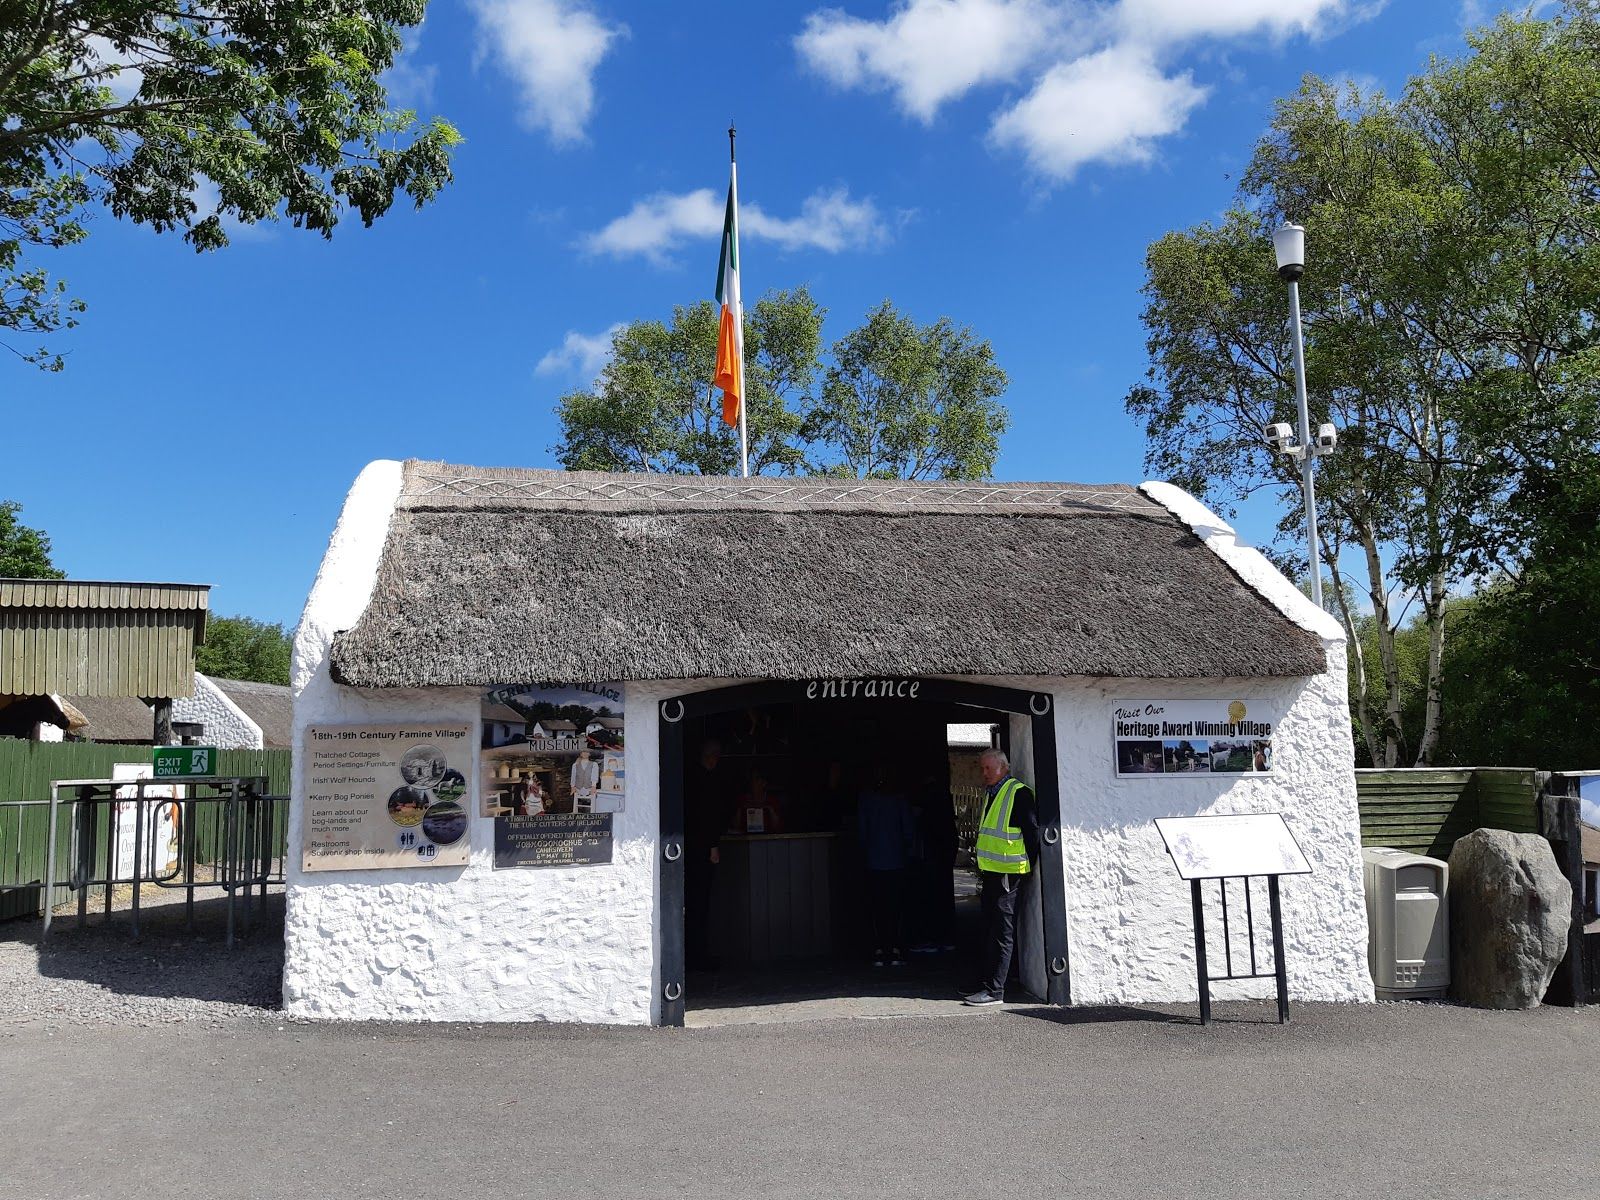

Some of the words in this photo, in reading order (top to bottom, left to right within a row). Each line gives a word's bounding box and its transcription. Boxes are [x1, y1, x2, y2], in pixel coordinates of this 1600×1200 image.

[806, 679, 920, 699] entrance
[1115, 707, 1141, 720] Visit
[1144, 704, 1165, 716] Our
[1117, 720, 1160, 738] Heritage
[1162, 721, 1193, 737] Award
[1194, 721, 1236, 738] Winning
[1237, 720, 1271, 738] Village
[313, 731, 357, 740] 18th-19th
[360, 731, 397, 740] Century
[399, 730, 433, 739] Famine
[435, 730, 466, 739] Village
[528, 739, 580, 751] MUSEUM
[314, 751, 347, 759] Thatched
[348, 751, 381, 759] Cottages
[157, 757, 182, 767] EXIT
[313, 761, 335, 769] Period
[157, 767, 181, 775] ONLY
[312, 793, 333, 802] Kerry
[334, 793, 349, 801] Bog
[350, 792, 375, 800] Ponies
[312, 809, 333, 817] Learn
[348, 816, 362, 824] and
[311, 840, 350, 848] Restrooms
[311, 849, 344, 857] Souvenir
[344, 848, 363, 856] shop
[363, 847, 385, 855] inside
